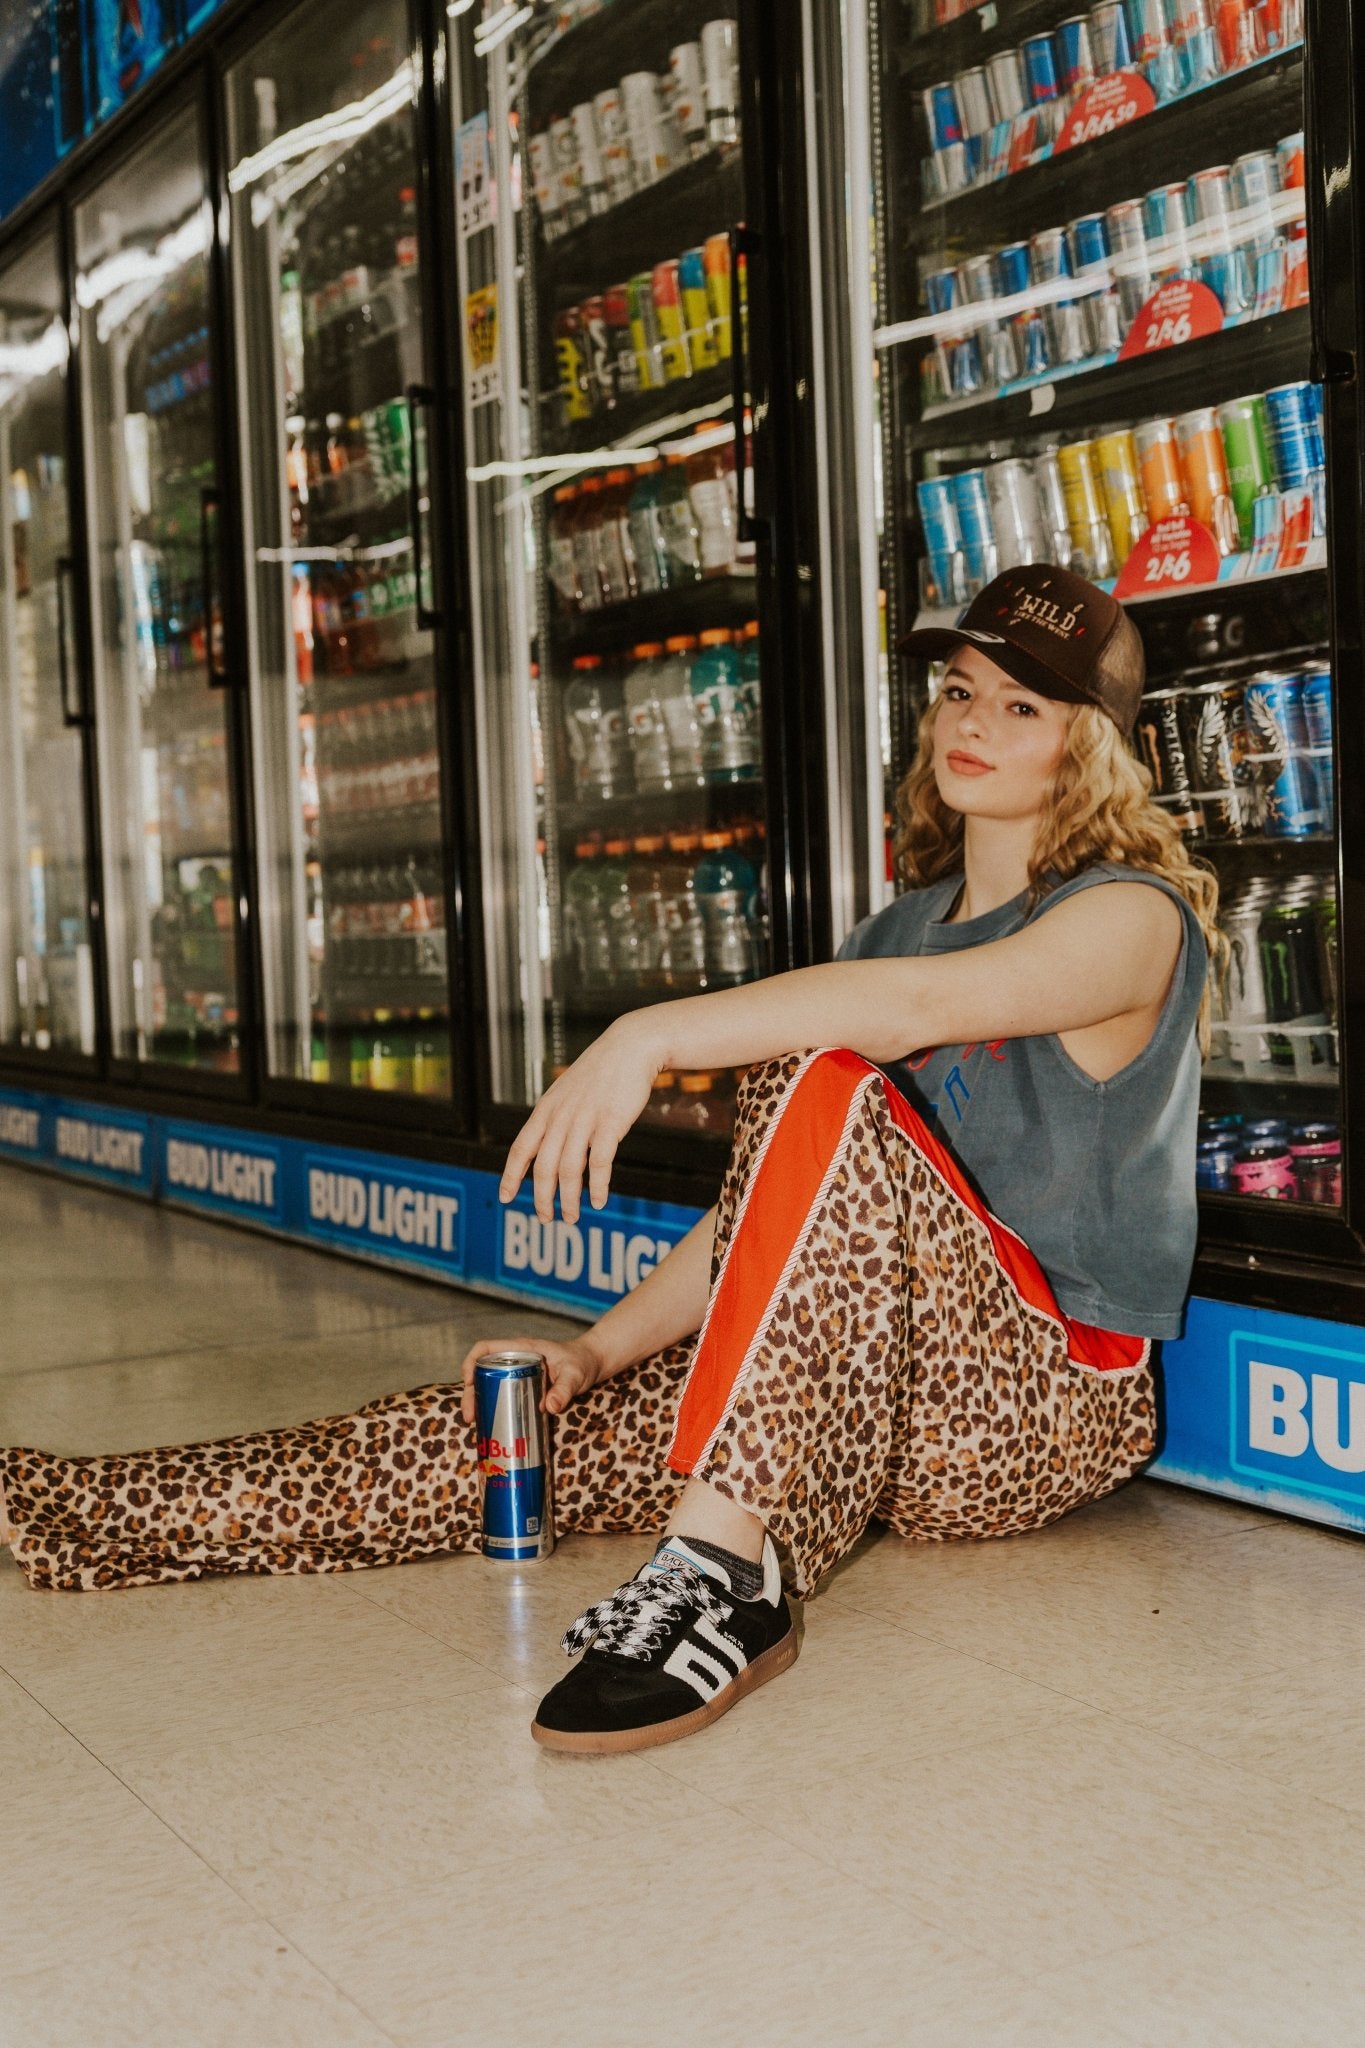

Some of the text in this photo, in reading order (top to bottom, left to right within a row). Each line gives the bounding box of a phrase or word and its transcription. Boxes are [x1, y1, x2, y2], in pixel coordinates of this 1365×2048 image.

[1018, 593, 1077, 631] WILD
[167, 1139, 276, 1206] BUD LIGHT
[309, 1168, 458, 1251] BUD LIGHT
[504, 1209, 673, 1294] BUD LIG
[1249, 1360, 1365, 1473] BU
[661, 1553, 687, 1567] BACK
